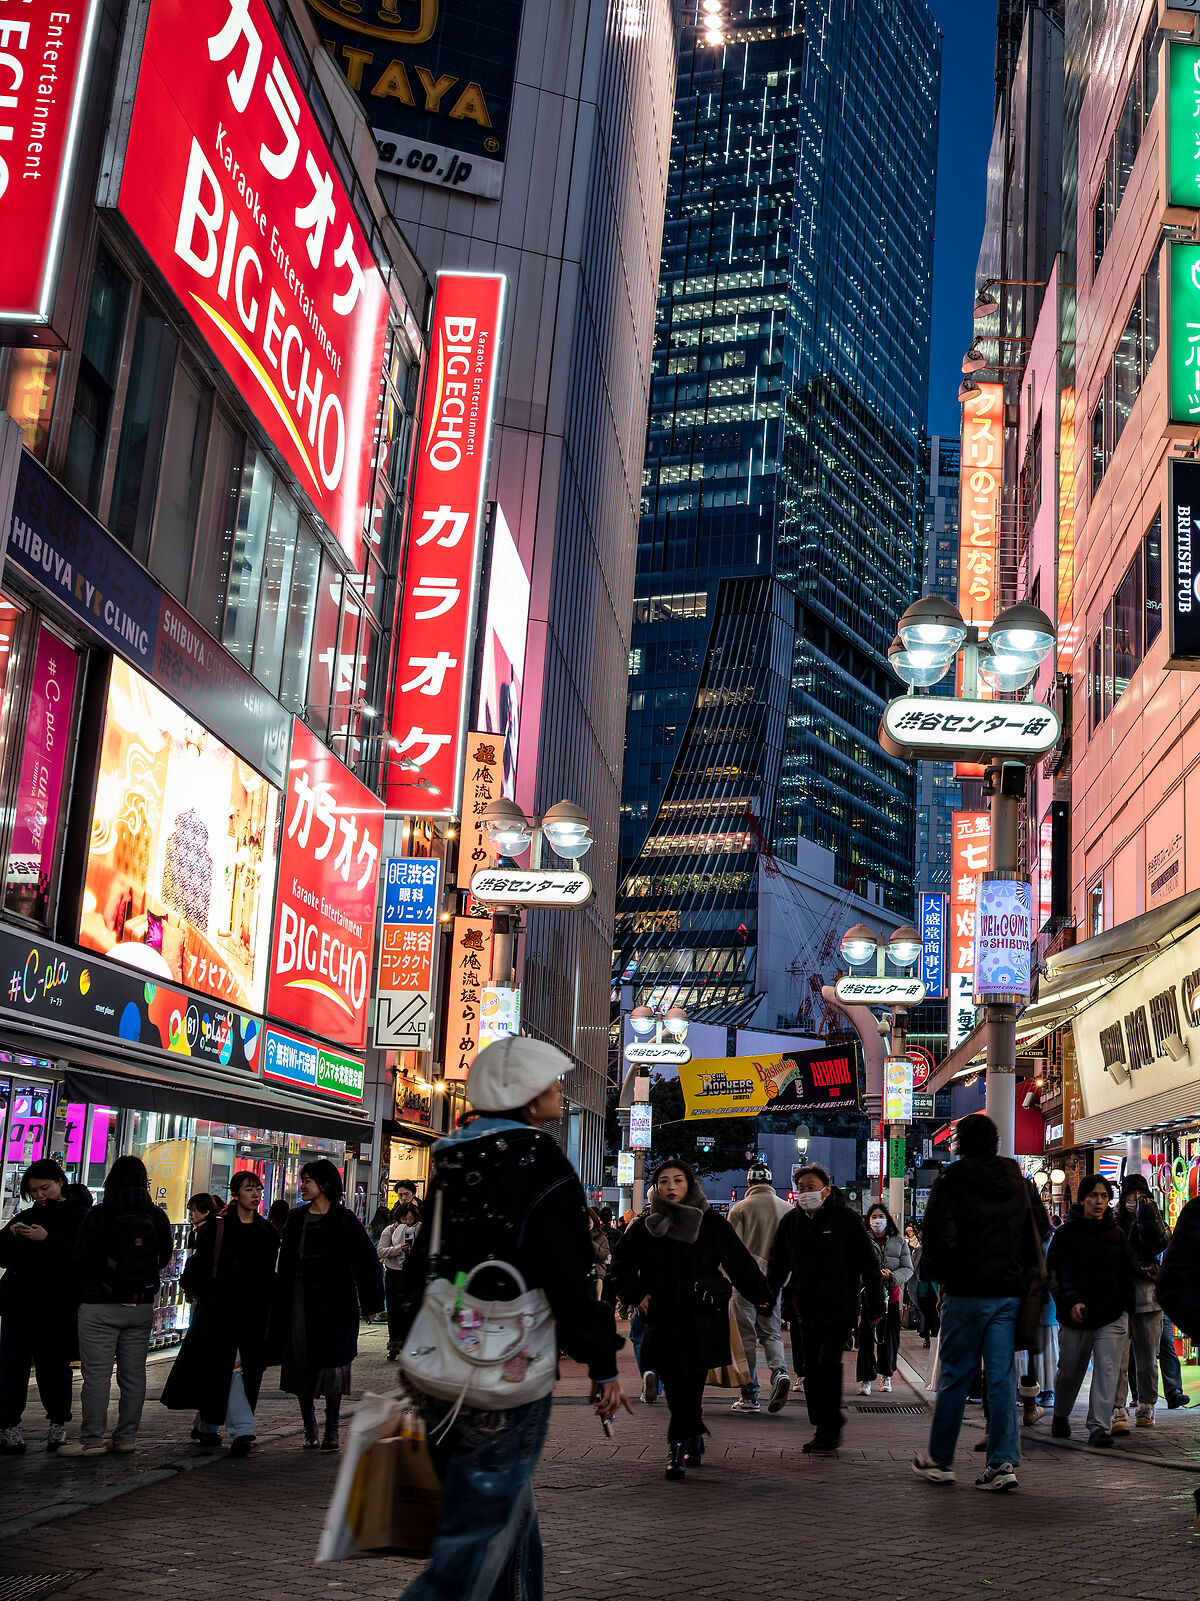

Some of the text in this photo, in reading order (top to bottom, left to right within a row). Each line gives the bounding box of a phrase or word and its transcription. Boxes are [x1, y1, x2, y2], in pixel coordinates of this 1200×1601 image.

[23, 12, 70, 180] Entertainment
[325, 39, 492, 129] TAYA
[207, 0, 366, 316] カラオケ
[216, 121, 343, 379] Karaoke Entertainment
[174, 135, 346, 491] BIG ECHO
[429, 316, 477, 471] BIG ECHO
[466, 331, 488, 456] Karaoke Entertainment
[966, 391, 996, 602] クスリのことなら
[1177, 505, 1192, 613] BRITISH PUB
[104, 599, 150, 656] CLINIC
[394, 504, 470, 771] カラオケ
[163, 608, 205, 668] SHIBUYA
[243, 690, 265, 719] LENS
[894, 711, 1052, 737] 渋谷センター街
[31, 764, 49, 850] CULTURE
[287, 770, 379, 892] カラオケ
[398, 887, 425, 903] 眼科
[407, 864, 438, 886] 渋谷
[475, 876, 585, 895] 渋谷センター街
[291, 877, 364, 940] Karaoke Entertainment
[386, 905, 435, 920] クリニック
[980, 913, 1030, 939] WELCOME
[276, 902, 367, 1011] BIG ECHO
[381, 954, 431, 970] コンタクト
[402, 930, 432, 952] 渋谷
[924, 898, 941, 993] 大盛堂商事ビル
[990, 937, 1031, 952] SHIBUYA
[391, 970, 421, 987] レンズ
[840, 983, 921, 996] 渋谷センター街
[186, 1017, 197, 1036] B1
[407, 1021, 427, 1034] 入口
[628, 1047, 687, 1059] 渋谷センター街
[275, 1038, 318, 1077] 無料Wi-Fi完備
